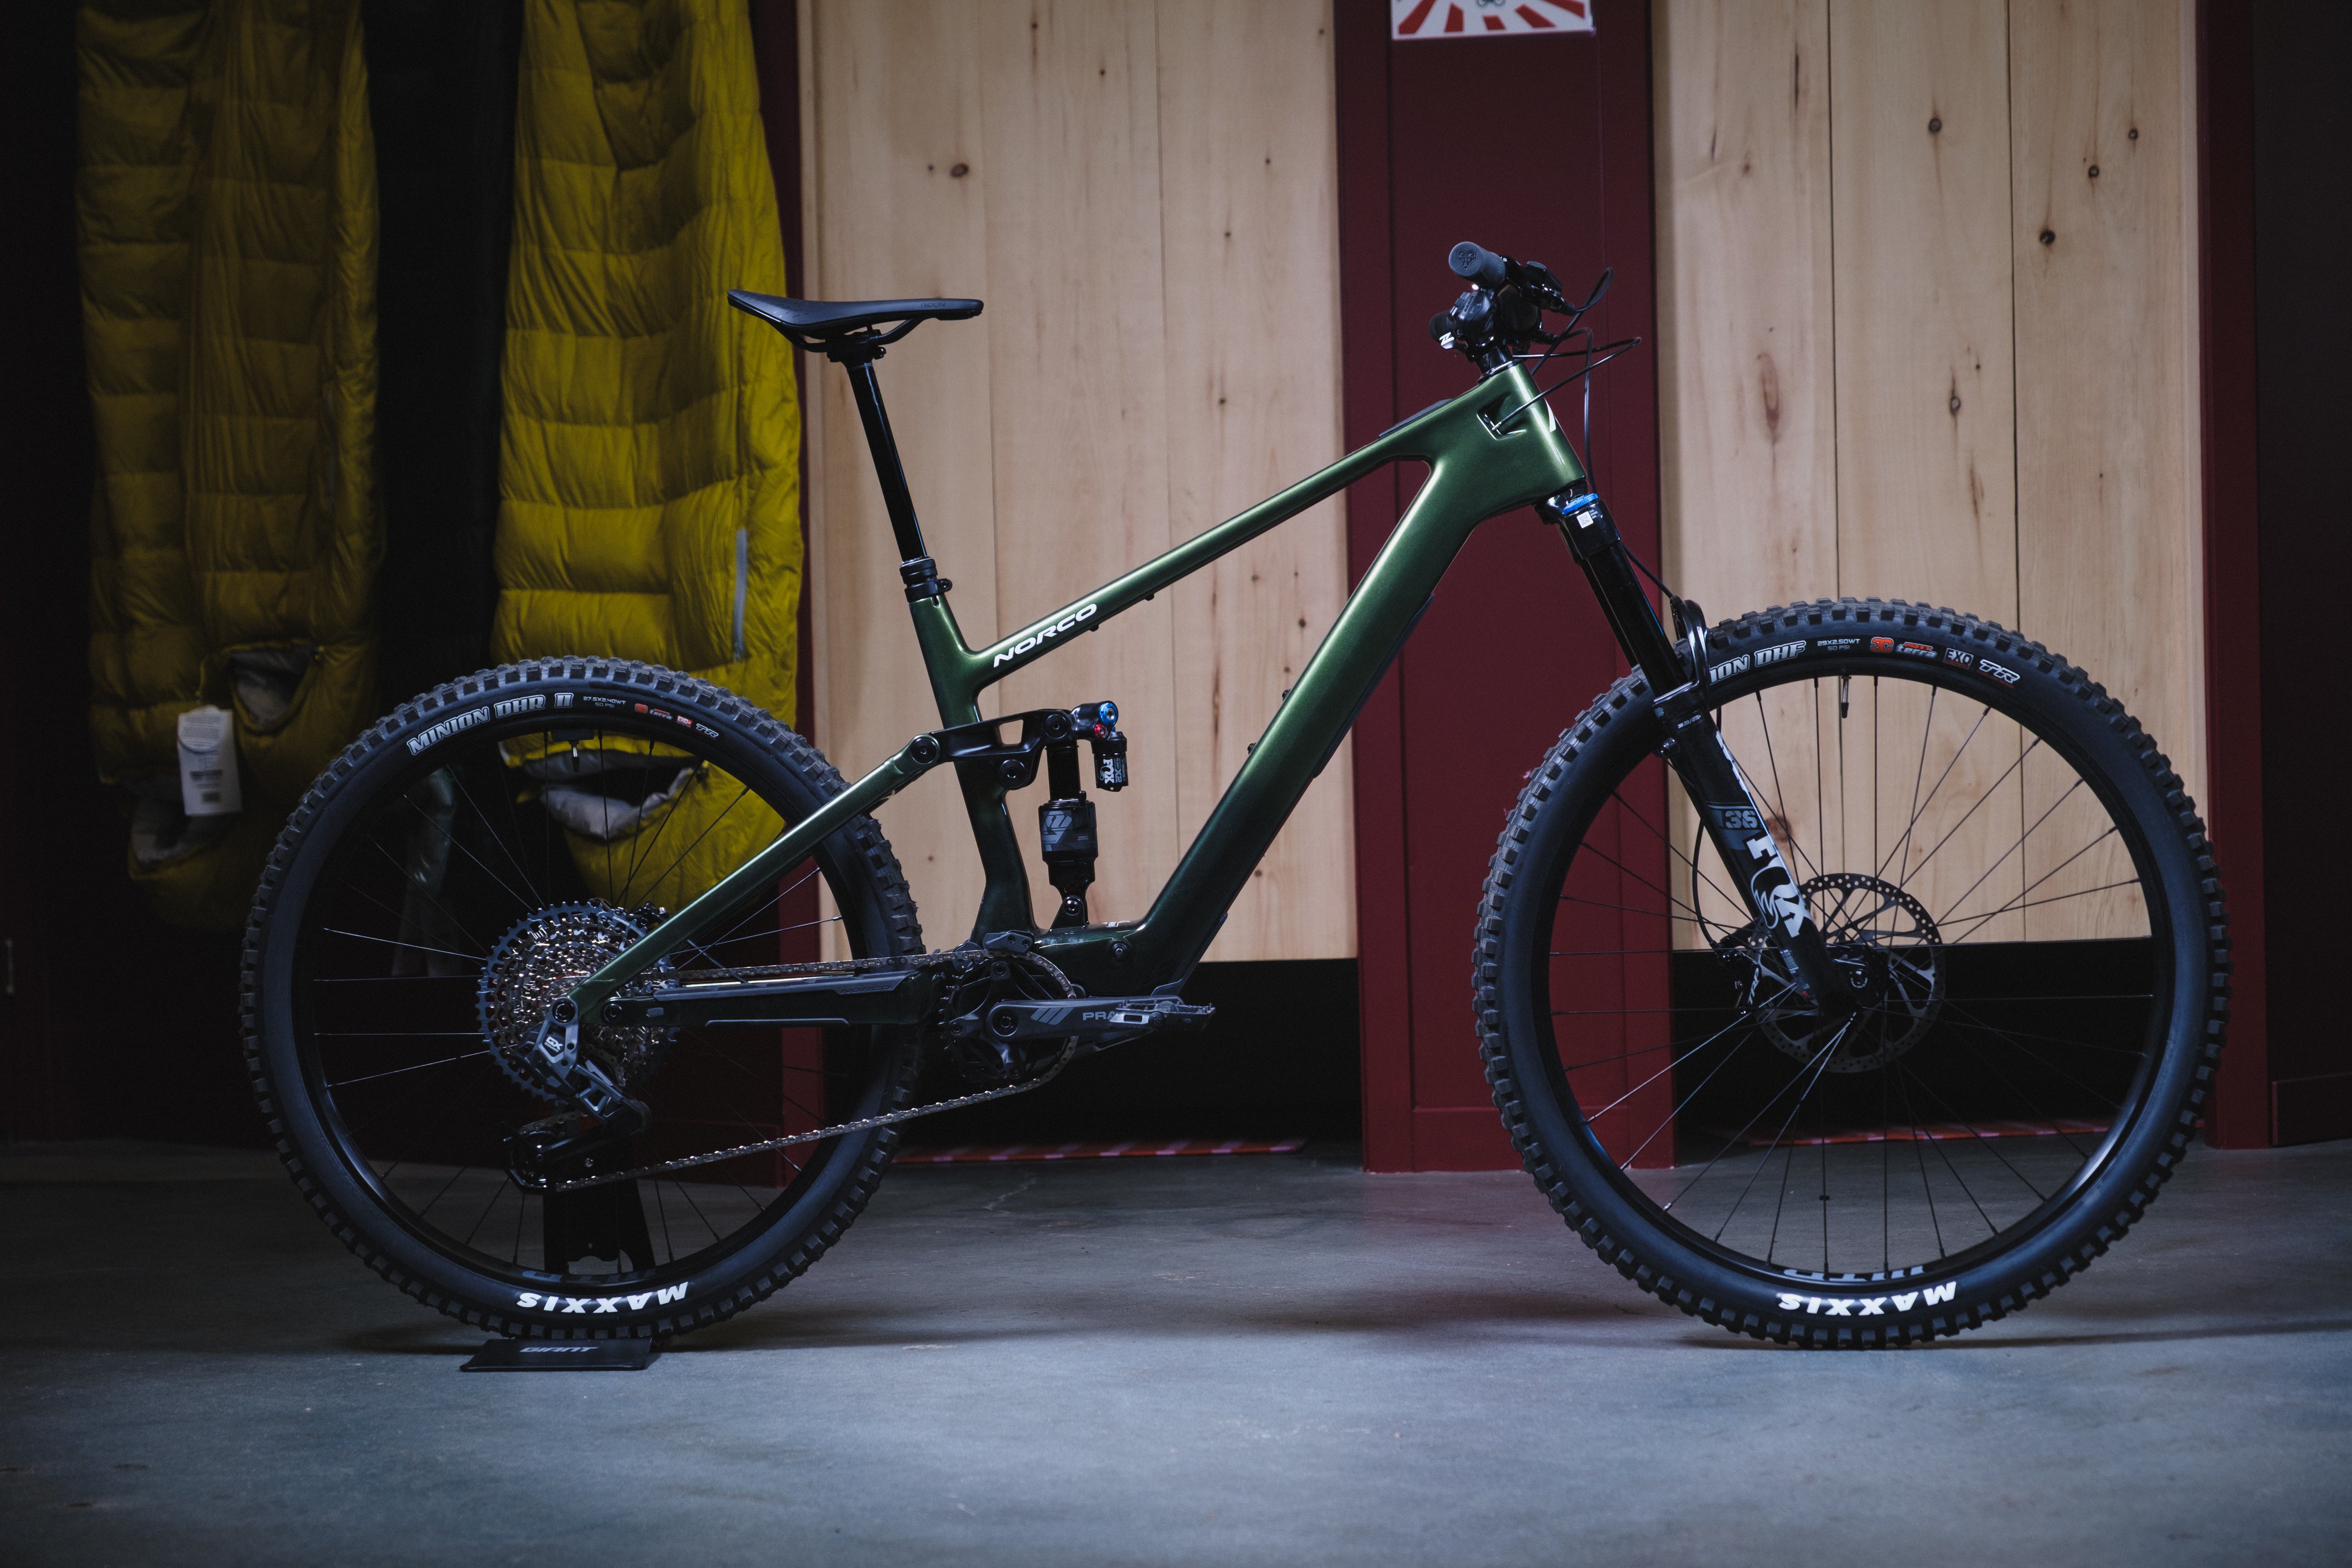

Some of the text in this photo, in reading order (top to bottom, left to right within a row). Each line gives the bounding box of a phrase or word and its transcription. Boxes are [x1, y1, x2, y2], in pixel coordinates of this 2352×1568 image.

[993, 603, 1097, 668] NORCO
[1870, 636, 1894, 653] 3C
[1754, 640, 1807, 668] DHF
[1895, 644, 1938, 659] terra
[1946, 649, 1972, 665] EXO
[1979, 659, 2021, 685] TR
[406, 706, 490, 756] MINION
[494, 694, 547, 719] DHR
[696, 723, 719, 739] TR
[1100, 758, 1115, 784] FOX
[1725, 810, 1759, 828] 36
[1746, 834, 1816, 938] FOX
[840, 985, 891, 994] NORCO
[516, 1281, 689, 1313] MAXXIS
[1777, 1281, 1957, 1316] MAXXIS
